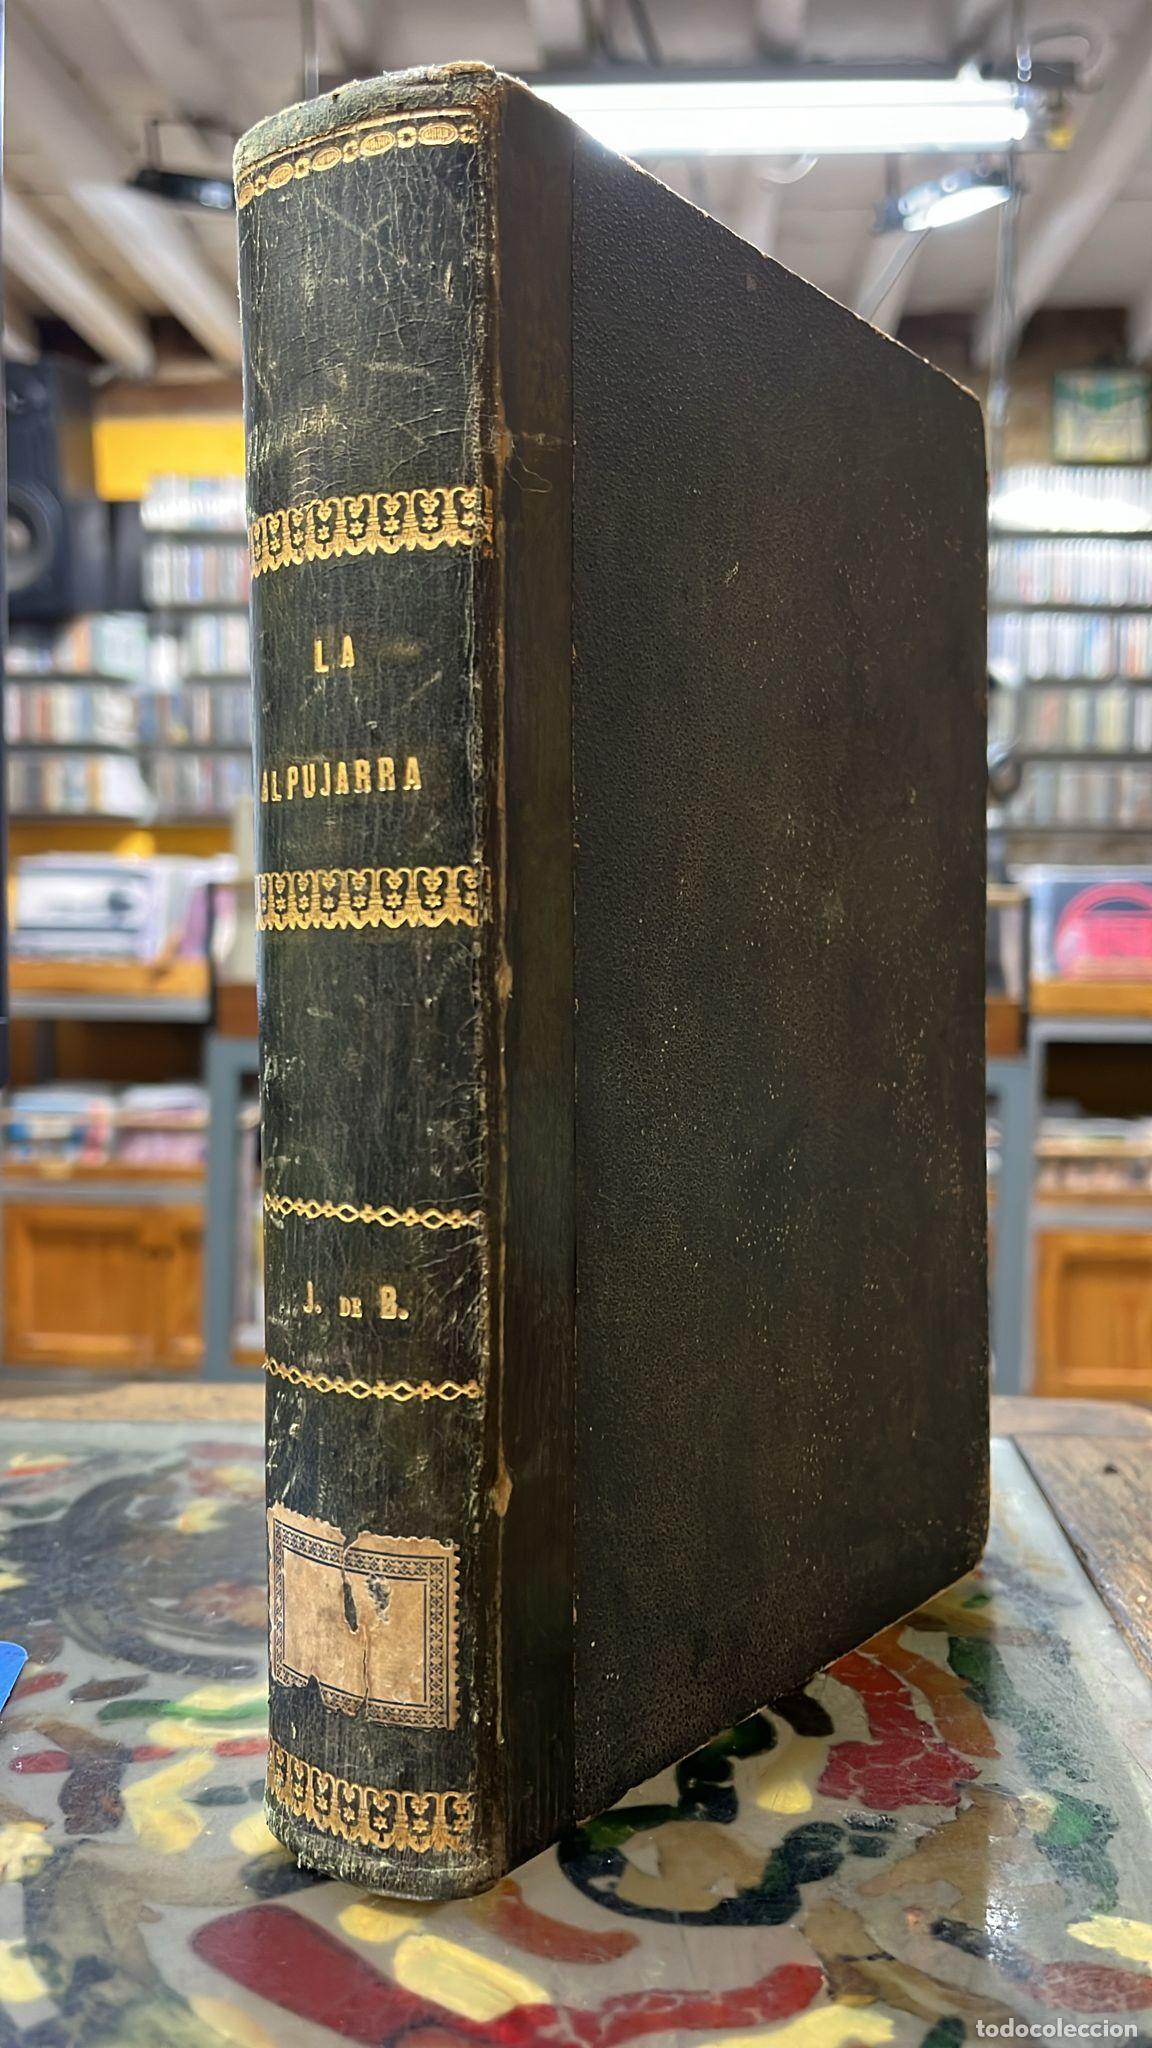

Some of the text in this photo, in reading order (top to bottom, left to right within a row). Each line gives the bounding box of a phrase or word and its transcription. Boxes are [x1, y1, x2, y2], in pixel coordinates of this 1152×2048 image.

[313, 635, 355, 673] LA
[261, 756, 422, 802] ALPUJARRA
[303, 1280, 322, 1314] J.
[339, 1295, 363, 1318] DE
